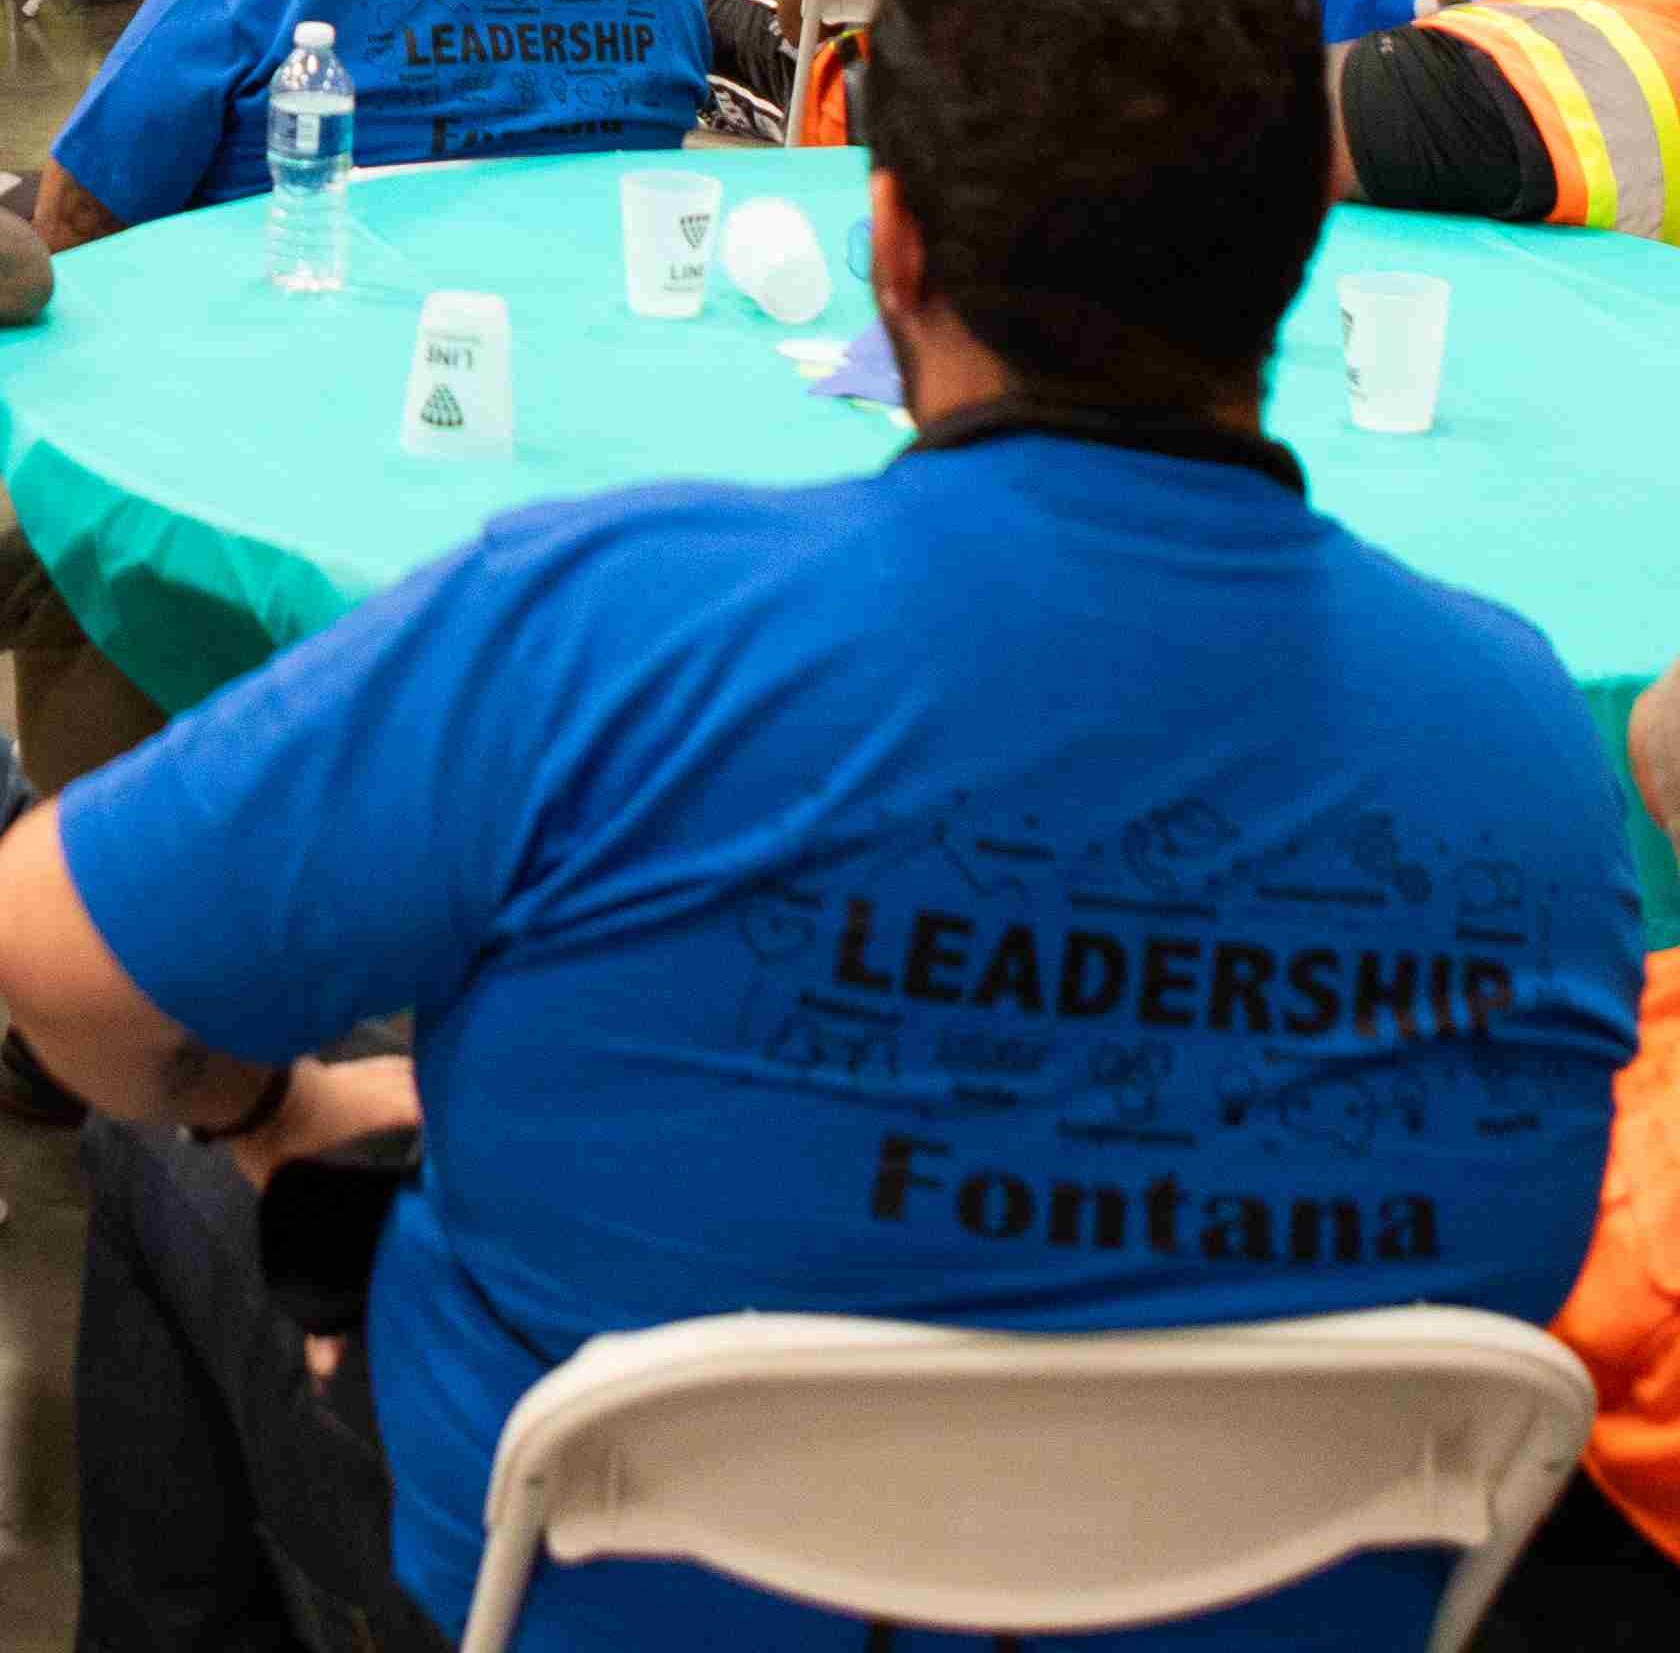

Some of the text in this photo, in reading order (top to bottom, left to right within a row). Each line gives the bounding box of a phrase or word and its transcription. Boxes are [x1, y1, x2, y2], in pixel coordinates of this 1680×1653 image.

[405, 20, 656, 67] LEADERSHIP
[834, 899, 1515, 1039] LEADERSHIP
[871, 1131, 1440, 1263] Fontana
